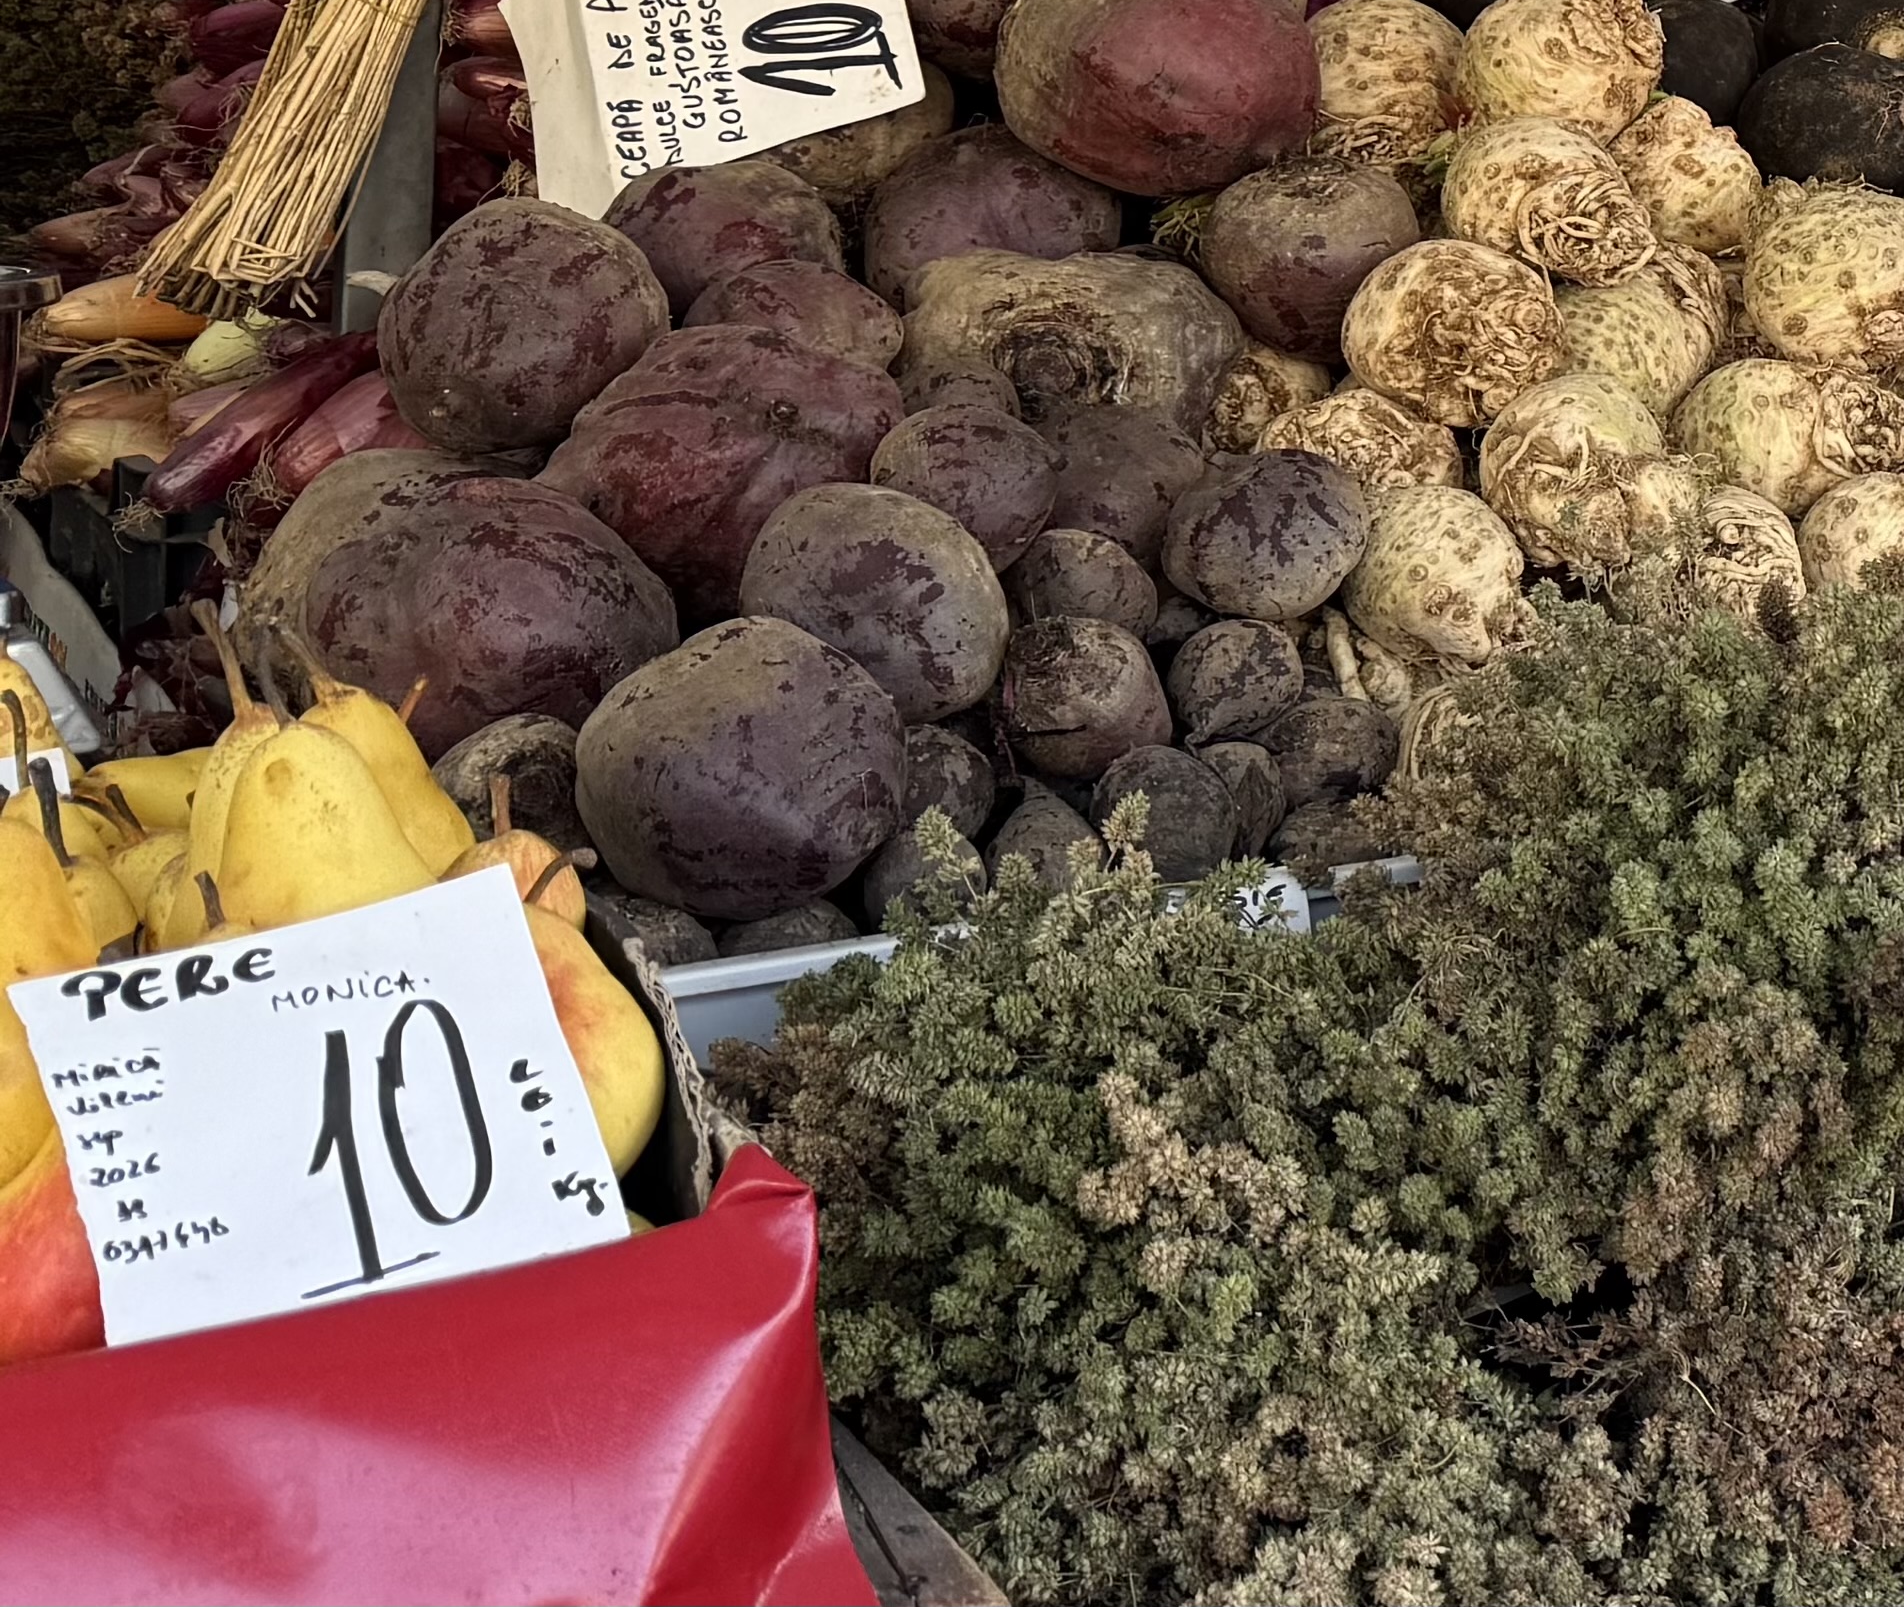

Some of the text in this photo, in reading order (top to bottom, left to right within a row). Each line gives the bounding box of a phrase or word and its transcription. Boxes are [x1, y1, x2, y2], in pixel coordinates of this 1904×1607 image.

[738, 2, 904, 97] 10
[60, 948, 276, 1021] PERE
[89, 1152, 161, 1188] 2026
[307, 999, 493, 1283] 10
